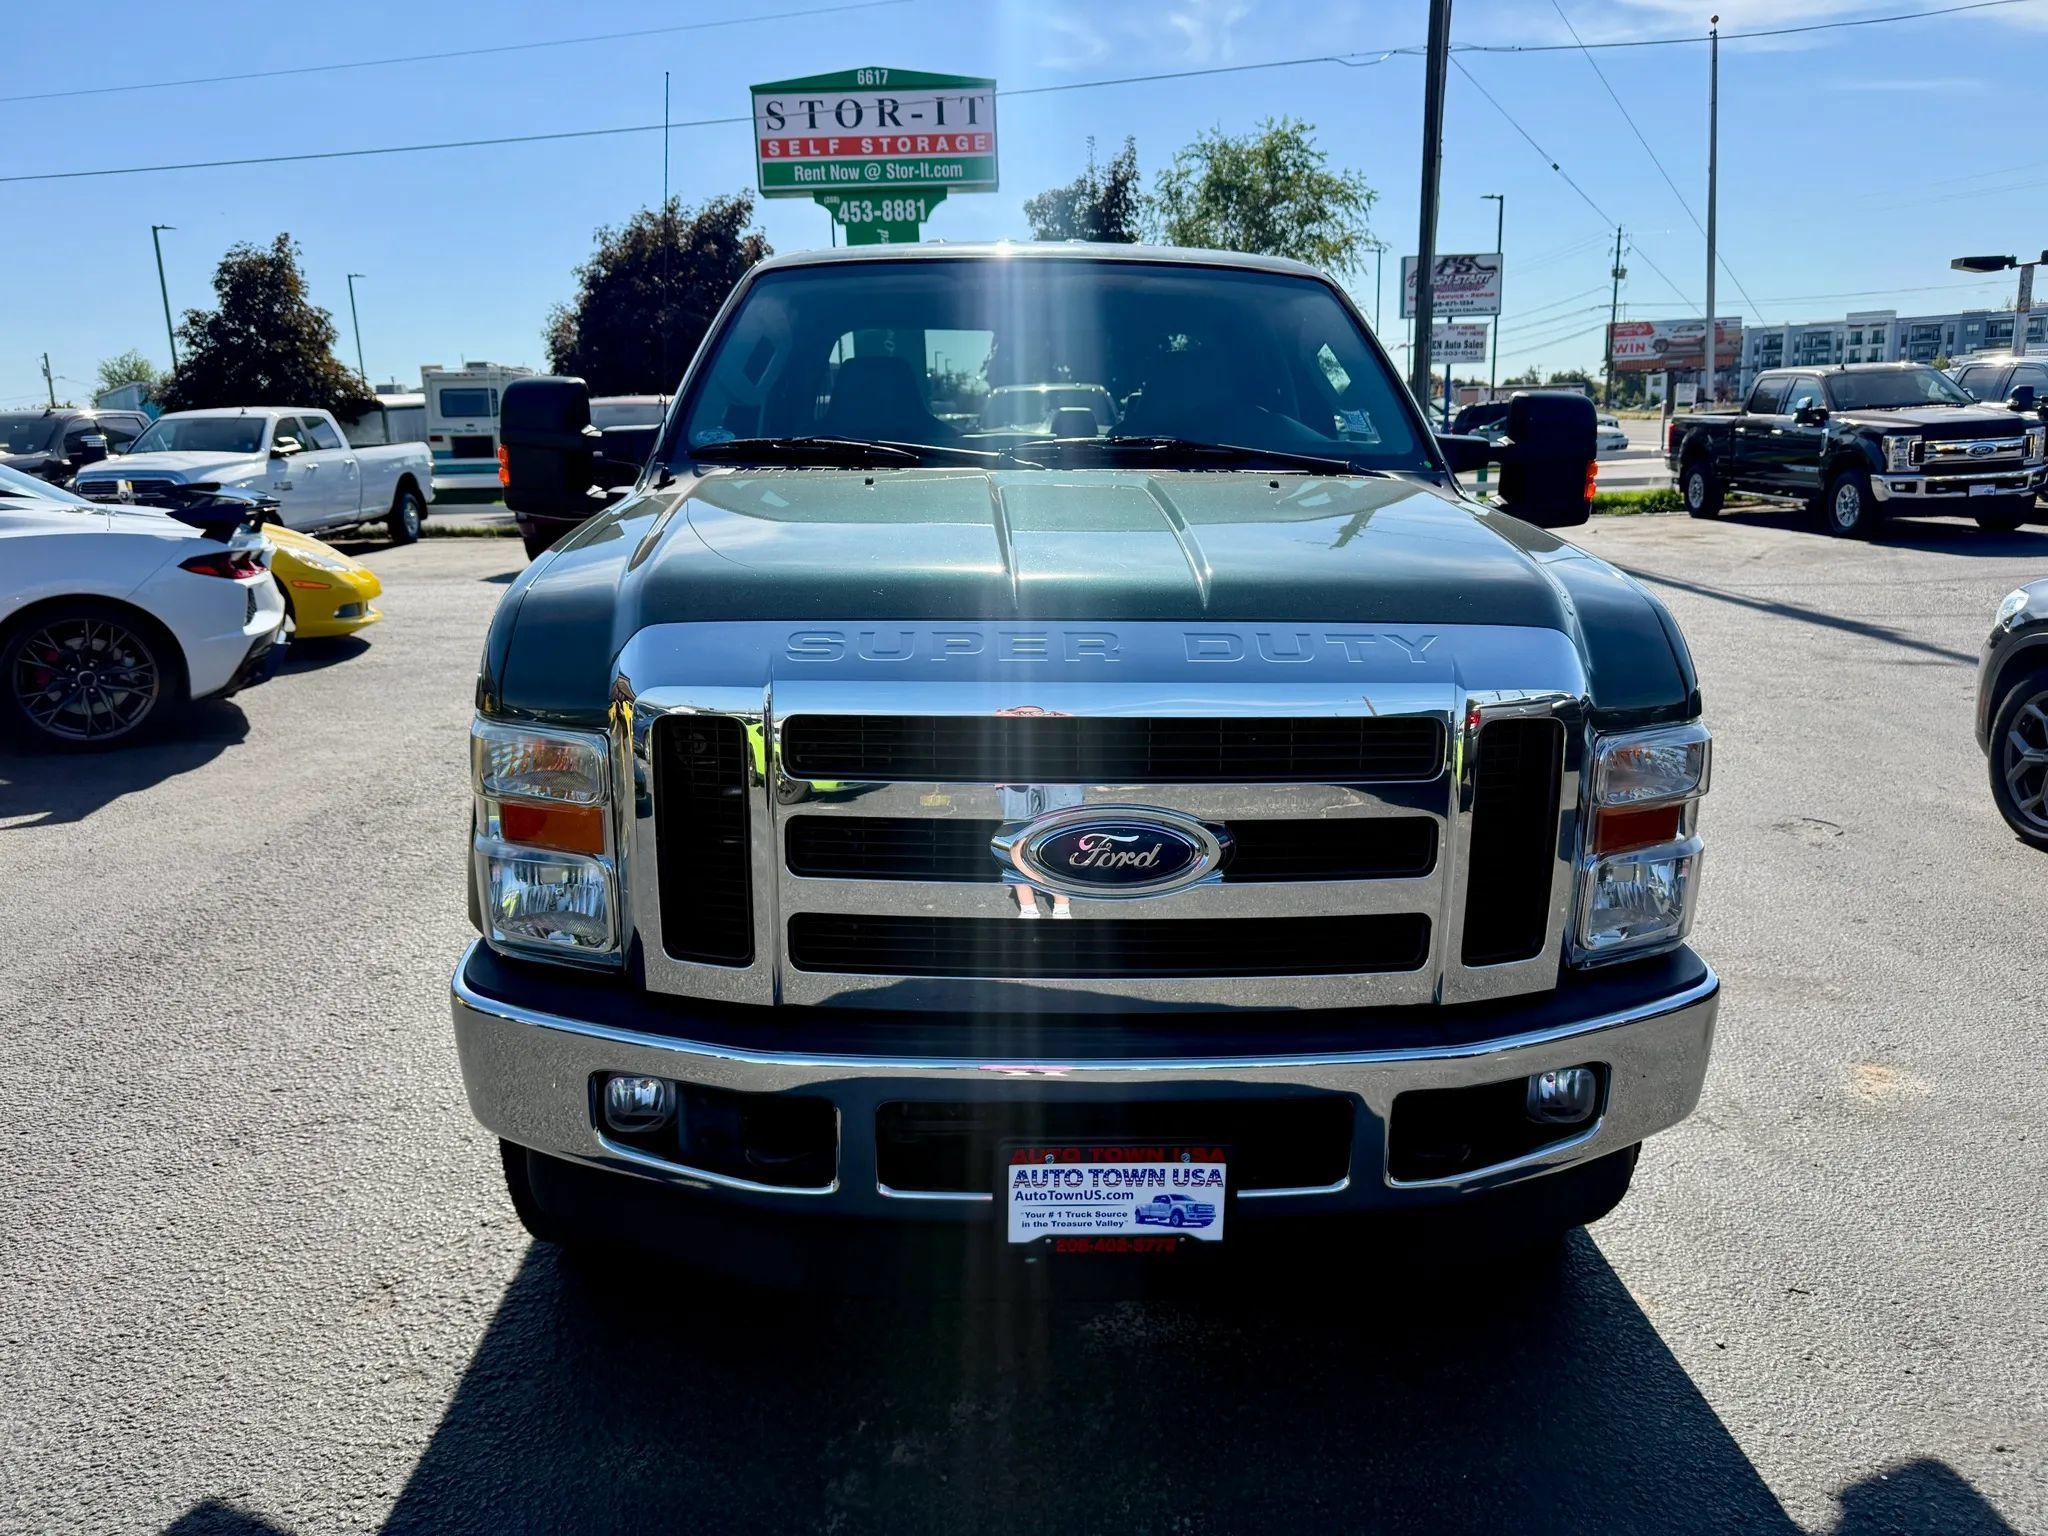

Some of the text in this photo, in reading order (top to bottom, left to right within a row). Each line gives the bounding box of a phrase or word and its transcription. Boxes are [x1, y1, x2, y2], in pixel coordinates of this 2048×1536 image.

[857, 69, 888, 86] 6617
[766, 96, 985, 131] STOR-IT
[768, 135, 987, 156] SELF STORAGE
[794, 162, 963, 182] Rent Now @ Stor-It.com
[838, 198, 926, 223] 453-8881
[1444, 340, 1461, 349] Auto
[1463, 339, 1484, 349] Sales
[1615, 342, 1646, 353] WIN
[785, 630, 1439, 664] SUPER DUTY
[1068, 833, 1163, 868] Ford
[1090, 1147, 1165, 1163] TOWN
[1013, 1168, 1224, 1189] AUTO TOWN USA
[1014, 1190, 1134, 1201] AutoTownUS.com
[1065, 1210, 1092, 1218] Truck
[1095, 1210, 1128, 1218] Source
[1033, 1220, 1049, 1228] the
[1051, 1220, 1093, 1228] Treasure
